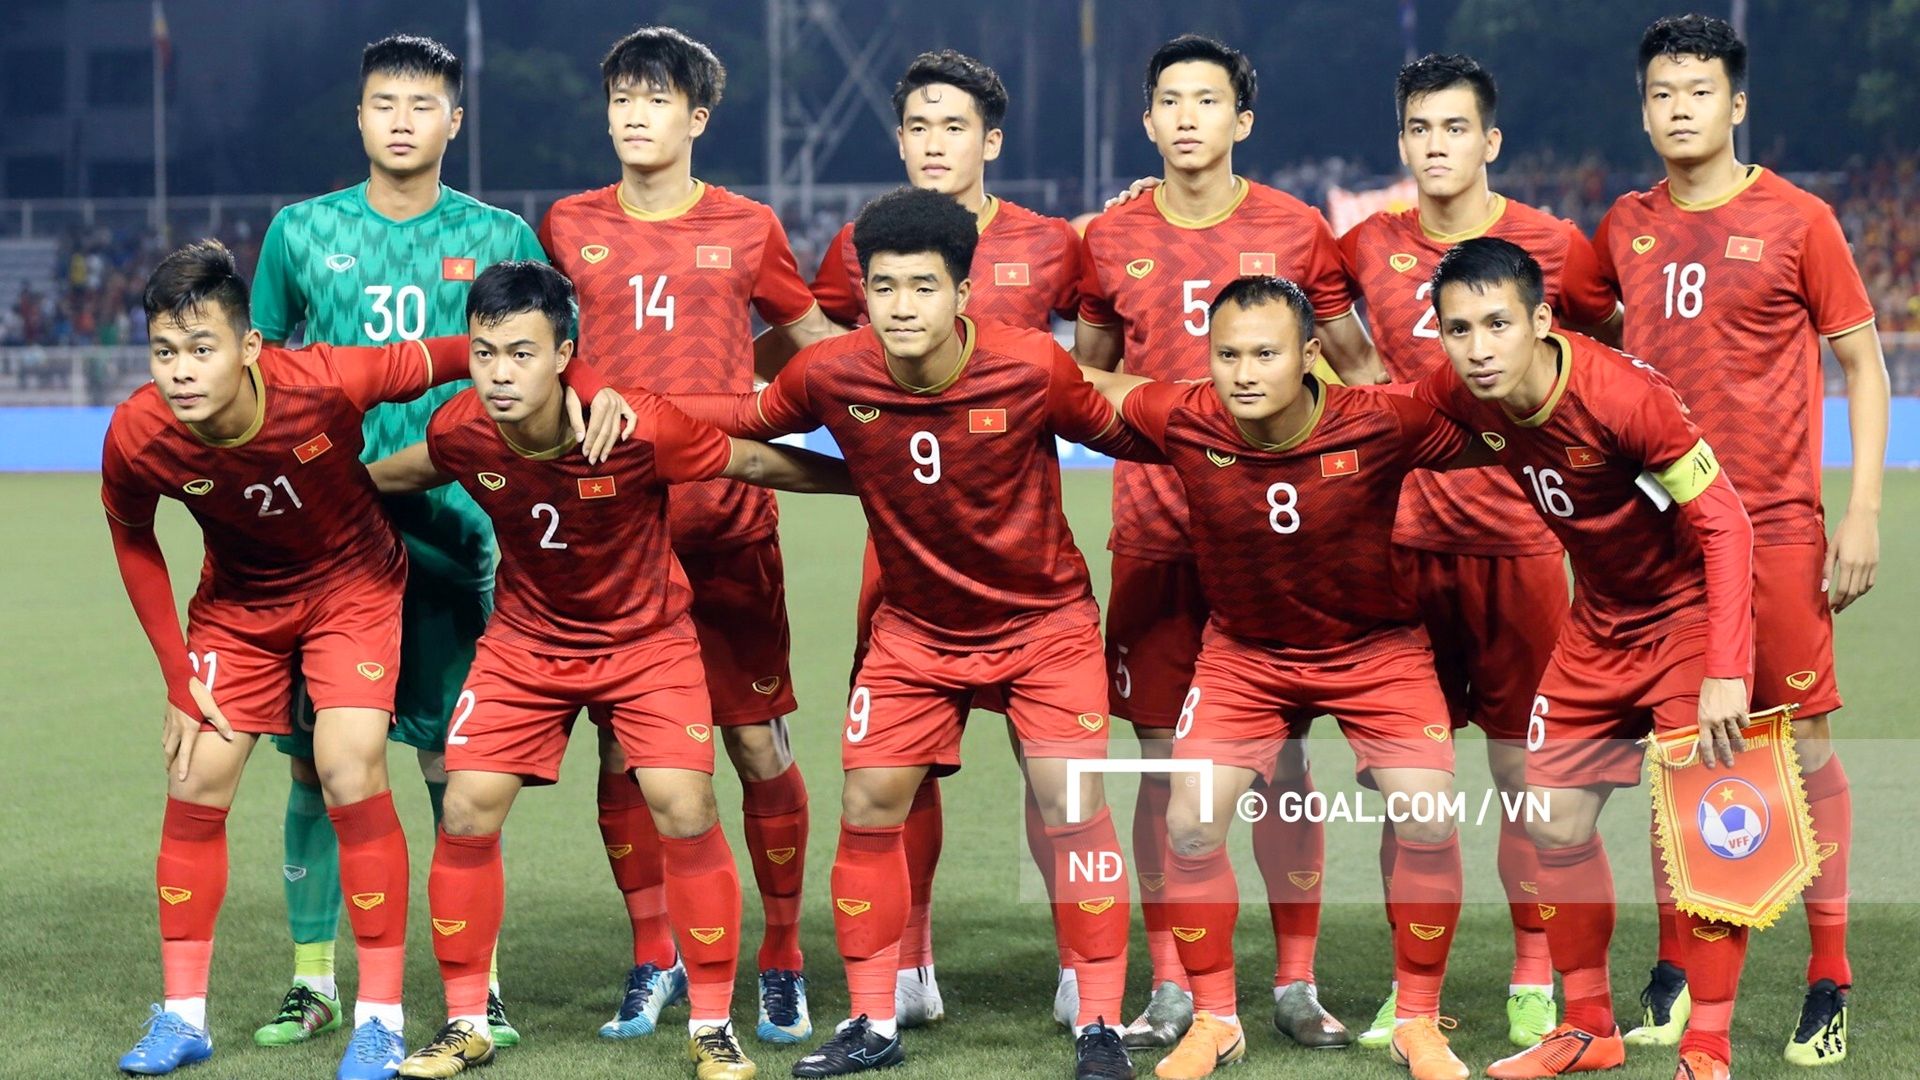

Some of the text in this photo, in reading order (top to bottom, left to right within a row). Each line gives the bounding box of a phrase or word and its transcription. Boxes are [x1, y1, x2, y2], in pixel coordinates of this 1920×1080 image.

[364, 285, 427, 341] 30
[629, 274, 675, 332] 14
[1183, 279, 1212, 337] 5
[1662, 262, 1707, 319] 18
[909, 430, 941, 484] 9
[244, 475, 303, 518] 21
[1267, 482, 1299, 534] 8
[1523, 465, 1574, 518] 16
[531, 503, 568, 549] 2
[448, 689, 476, 746] 2
[847, 686, 871, 742] 9
[1175, 686, 1201, 741] 8
[1728, 835, 1750, 850] VFF
